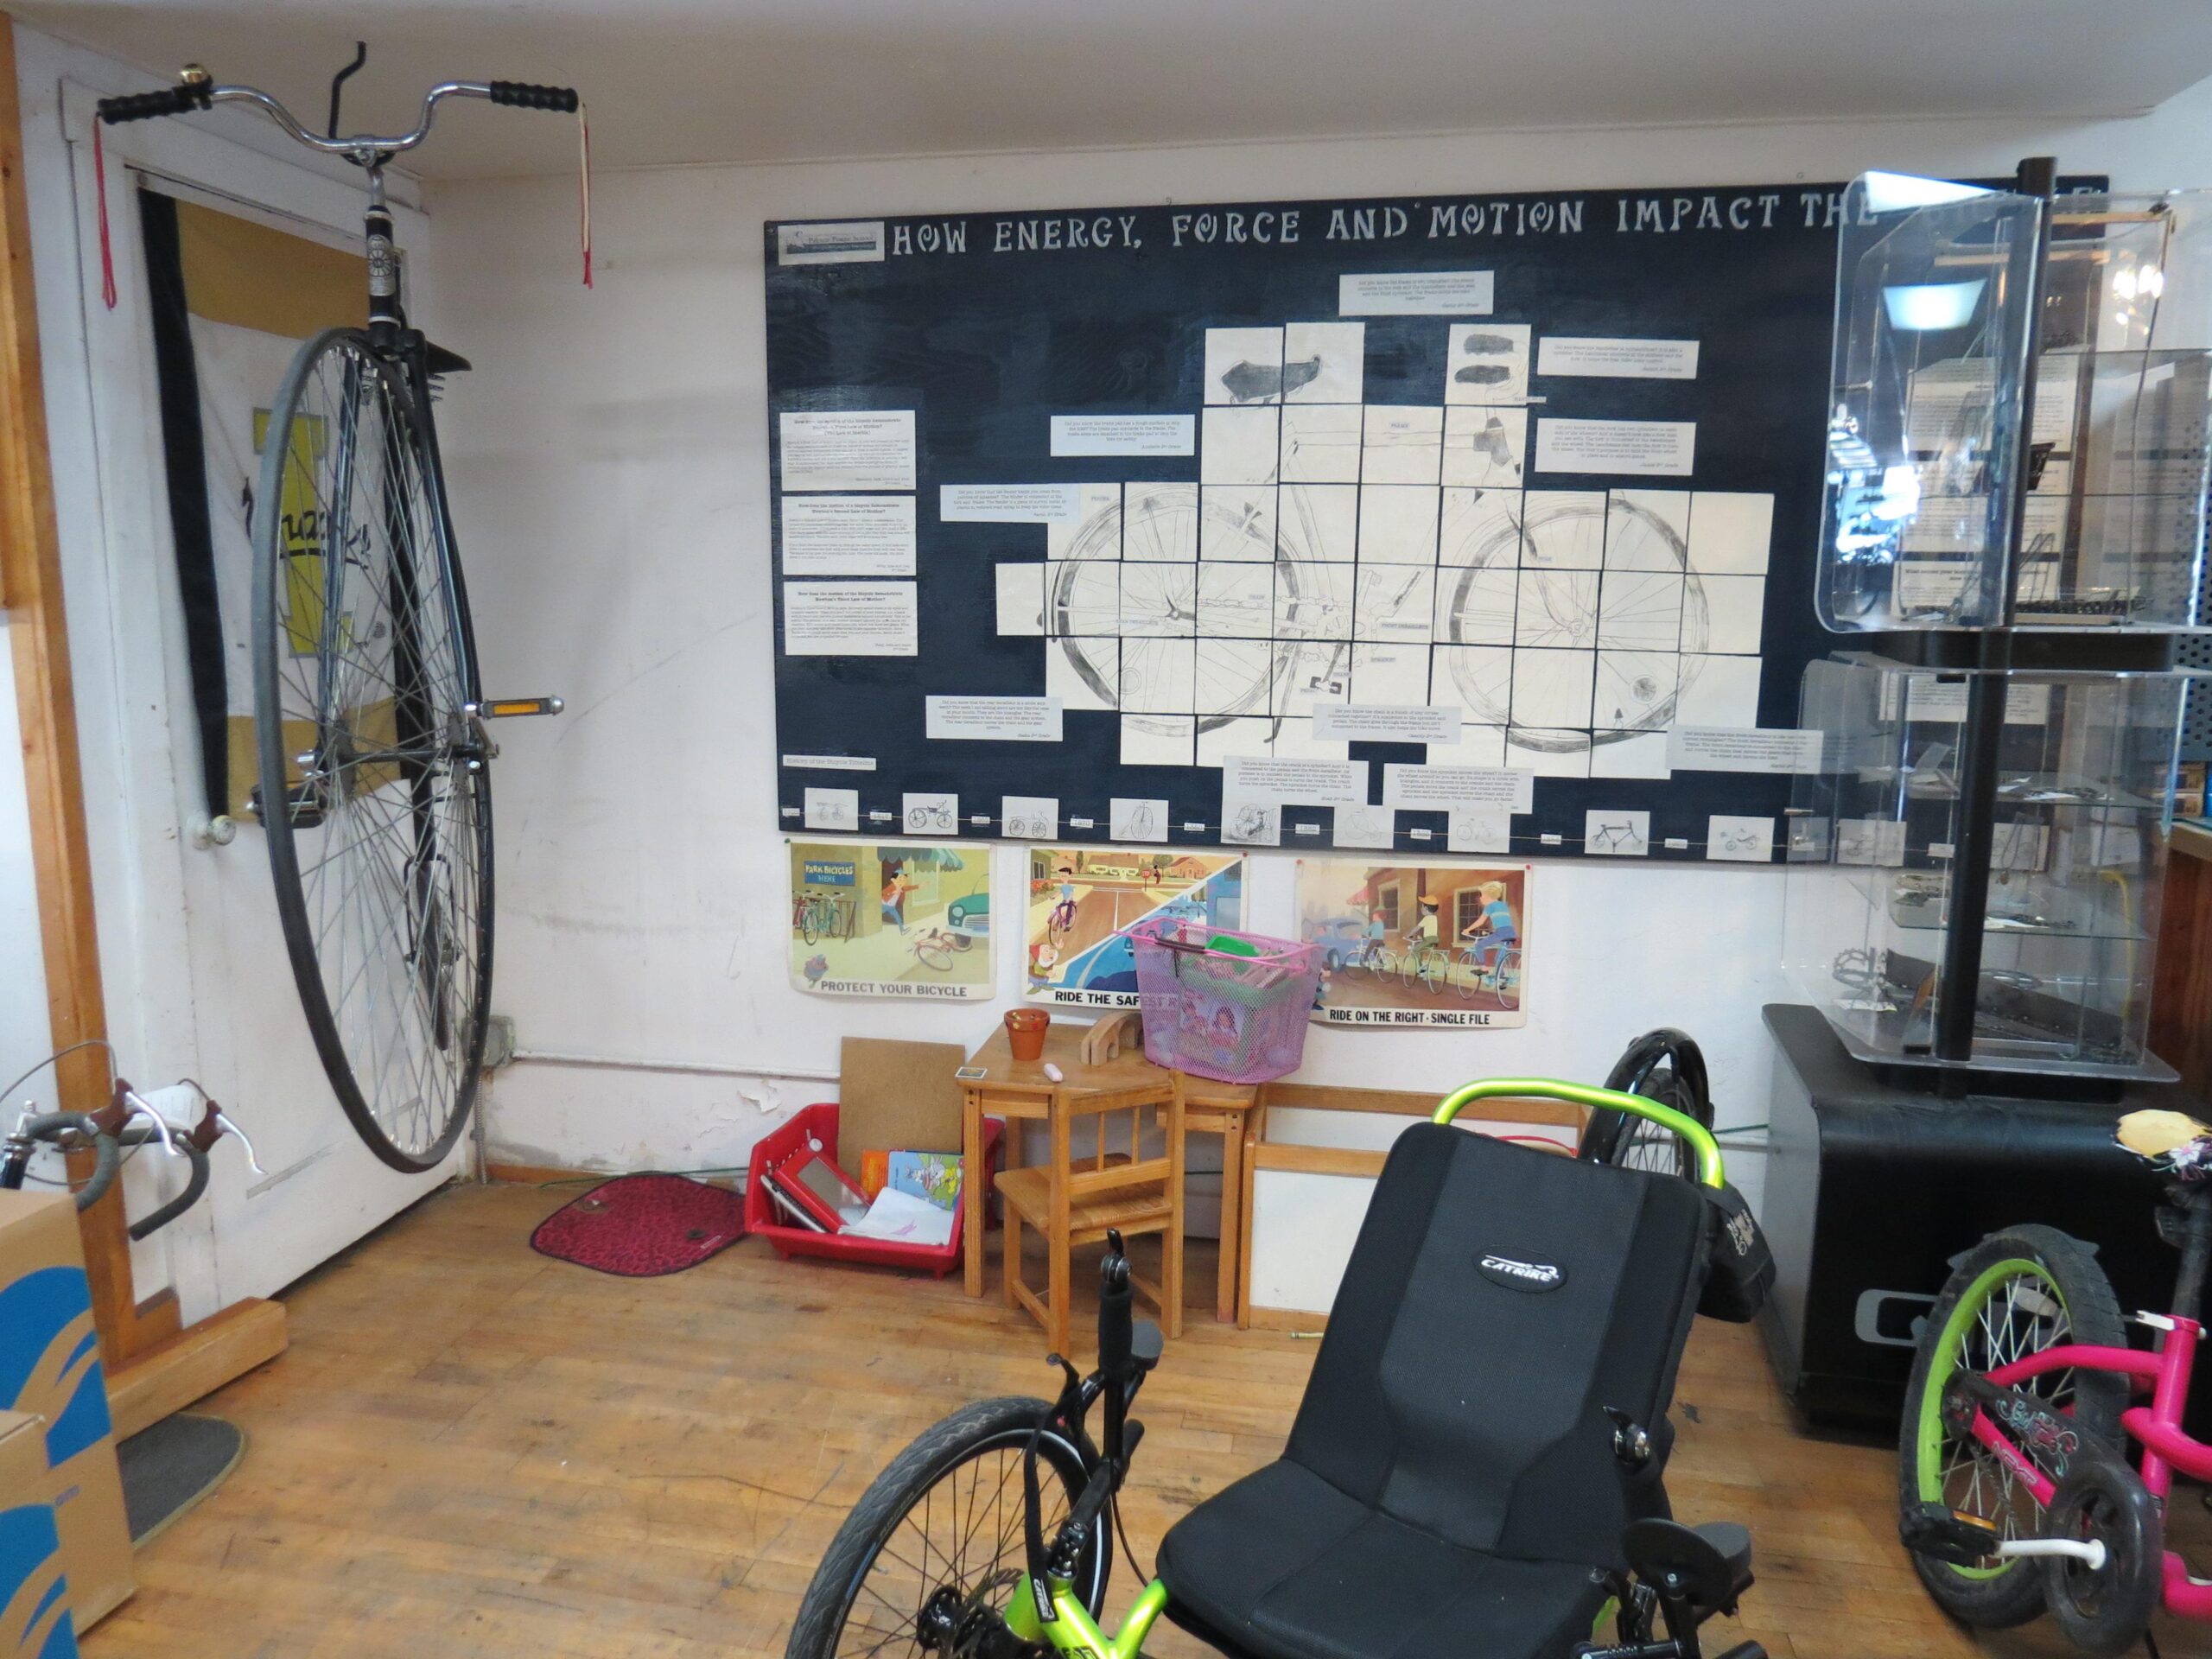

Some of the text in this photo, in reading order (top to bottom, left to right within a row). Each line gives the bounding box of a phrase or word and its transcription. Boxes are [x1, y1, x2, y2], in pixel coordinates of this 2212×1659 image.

[893, 221, 966, 255] HOW
[994, 216, 1142, 252] ENERGY,
[1173, 211, 1300, 246] FORCE
[1325, 207, 1408, 240] AND
[1427, 200, 1584, 238] MOTION
[1617, 194, 1780, 232] IMPACT
[805, 865, 854, 875] PARK BICYCLES
[821, 981, 968, 998] PROTECT YOUR BICYCLE
[1055, 990, 1083, 1002] RIDE
[1086, 993, 1110, 1005] THE
[1330, 1009, 1491, 1025] RIDE ON THE RIGHT SINGLE FILE
[1480, 1258, 1552, 1281] CATRIKE
[1033, 1578, 1049, 1618] CATRIKE
